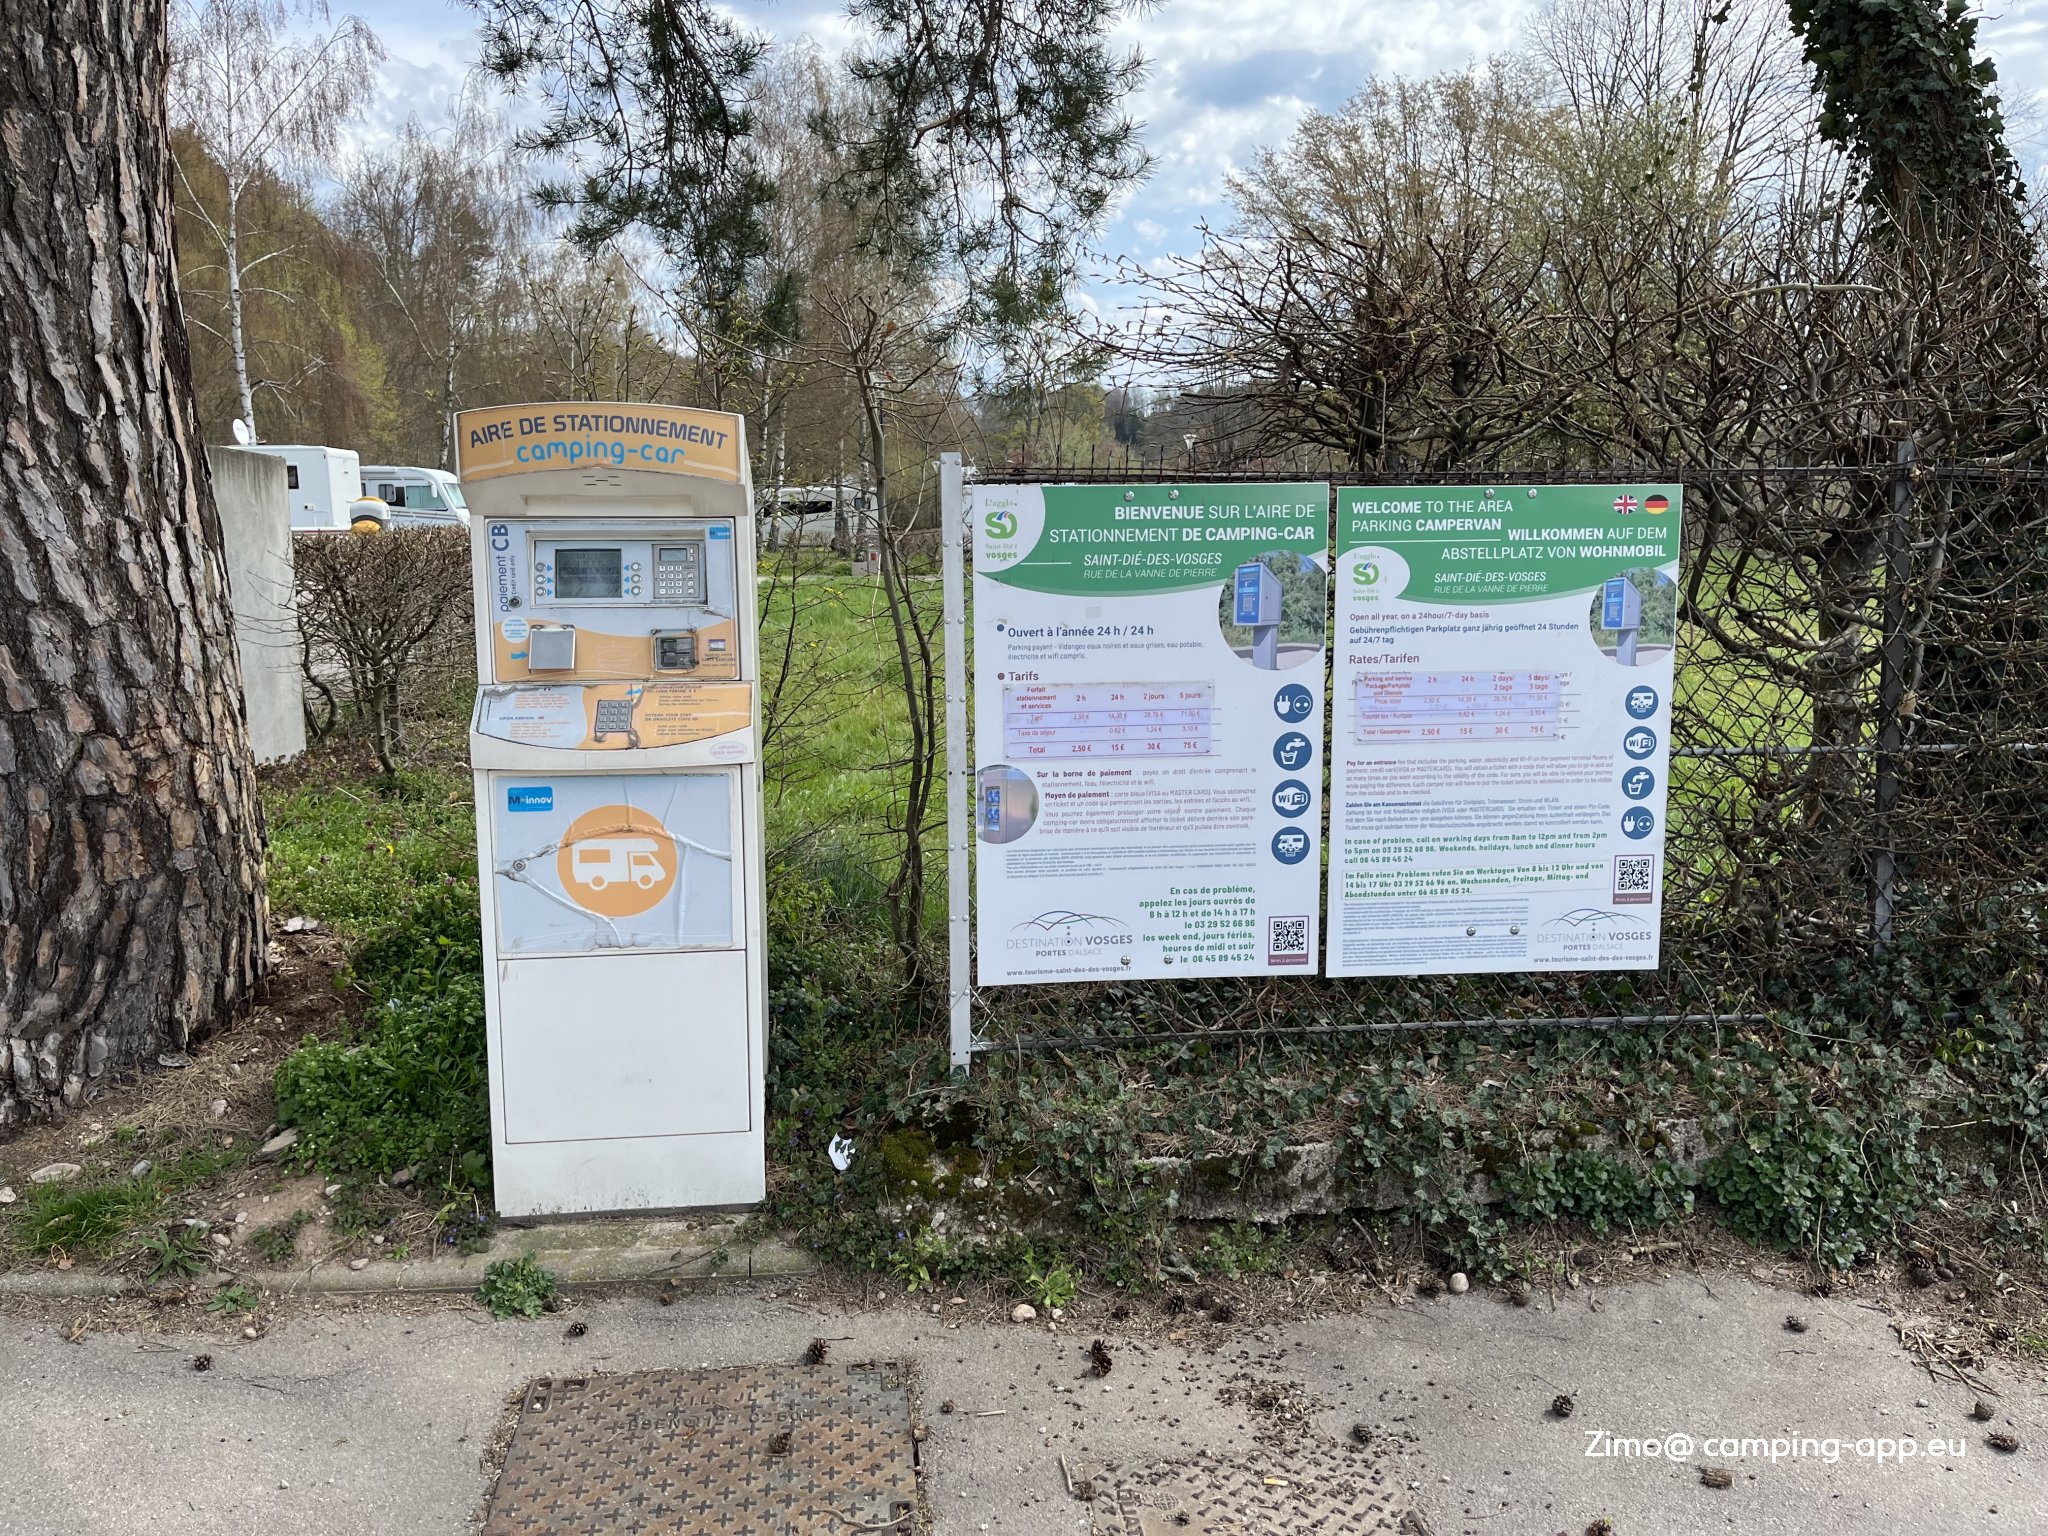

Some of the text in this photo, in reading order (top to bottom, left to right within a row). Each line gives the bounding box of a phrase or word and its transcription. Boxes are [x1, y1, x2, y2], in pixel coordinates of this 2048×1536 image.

[471, 415, 728, 449] AIRE DE STATIONNEMENT
[516, 434, 685, 464] camping-car
[1115, 504, 1316, 520] BIENVENUE SUR L'AIRE DE
[1352, 500, 1513, 514] WELCOME TO THE AREA
[1352, 518, 1501, 532] PARKING CAMPERVAN
[1050, 526, 1315, 543] STATIONNEMENT DE CAMPING-CAR
[1508, 527, 1667, 541] WILLKOMMEN AUF DEM
[986, 552, 1017, 560] vosges
[1441, 545, 1667, 560] ABSTELLPLATZ VON WOHNMOBIL
[1083, 551, 1222, 566] SAINT-DIÉ-DES-VOSGES
[492, 524, 511, 612] paiement CB
[1083, 568, 1217, 579] RUE DE LA VANNE DE PIERRE
[1434, 571, 1546, 583] SAINT-DIÉ-DES-VOSGES
[1434, 584, 1548, 594] RUE DE LA VANNE DE PIERRE
[1350, 613, 1369, 621] Open
[1418, 612, 1468, 620] 24hour/7-day
[1470, 611, 1489, 619] basis
[1008, 626, 1154, 637] Ouvert à l'année 24 h / 24 h
[1350, 625, 1424, 635] Gebührenpflichtigen
[1426, 625, 1461, 633] Parkplatz
[1481, 624, 1503, 633] jährig
[1505, 623, 1536, 632] geöffnet
[1363, 636, 1380, 644] 24/7
[1382, 637, 1394, 645] tag
[1349, 654, 1419, 664] Rates/Tarifen
[1008, 671, 1039, 681] Tarifs
[1016, 694, 1057, 702] stationnement
[1149, 693, 1165, 701] jours
[1185, 692, 1201, 700] jours
[1029, 746, 1046, 754] Total
[1156, 742, 1161, 750] €
[1170, 885, 1256, 896] En cas de problème,
[1139, 896, 1256, 909] appelez les jours ouvrés de
[1157, 910, 1162, 918] h
[1164, 909, 1169, 918] à
[1172, 910, 1180, 918] 12
[1182, 909, 1188, 917] h
[1201, 909, 1211, 917] de
[1213, 909, 1223, 917] 14
[1225, 908, 1230, 916] h
[1232, 907, 1237, 916] à
[1240, 908, 1248, 916] 17
[1185, 921, 1192, 929] le
[1194, 921, 1205, 929] 03
[1208, 920, 1218, 928] 29
[1220, 920, 1230, 928] 52
[1245, 919, 1255, 927] 96
[1007, 935, 1133, 949] DESTINATION VOSGES
[1143, 934, 1156, 942] les
[1158, 932, 1180, 941] week
[1183, 932, 1201, 941] end,
[1202, 932, 1225, 942] jours
[1537, 932, 1652, 943] DESTINATION VOSGES
[1162, 942, 1255, 953] heures de midi et soir
[1192, 955, 1203, 963] 06
[1218, 954, 1228, 962] 89
[1243, 953, 1255, 961] 24
